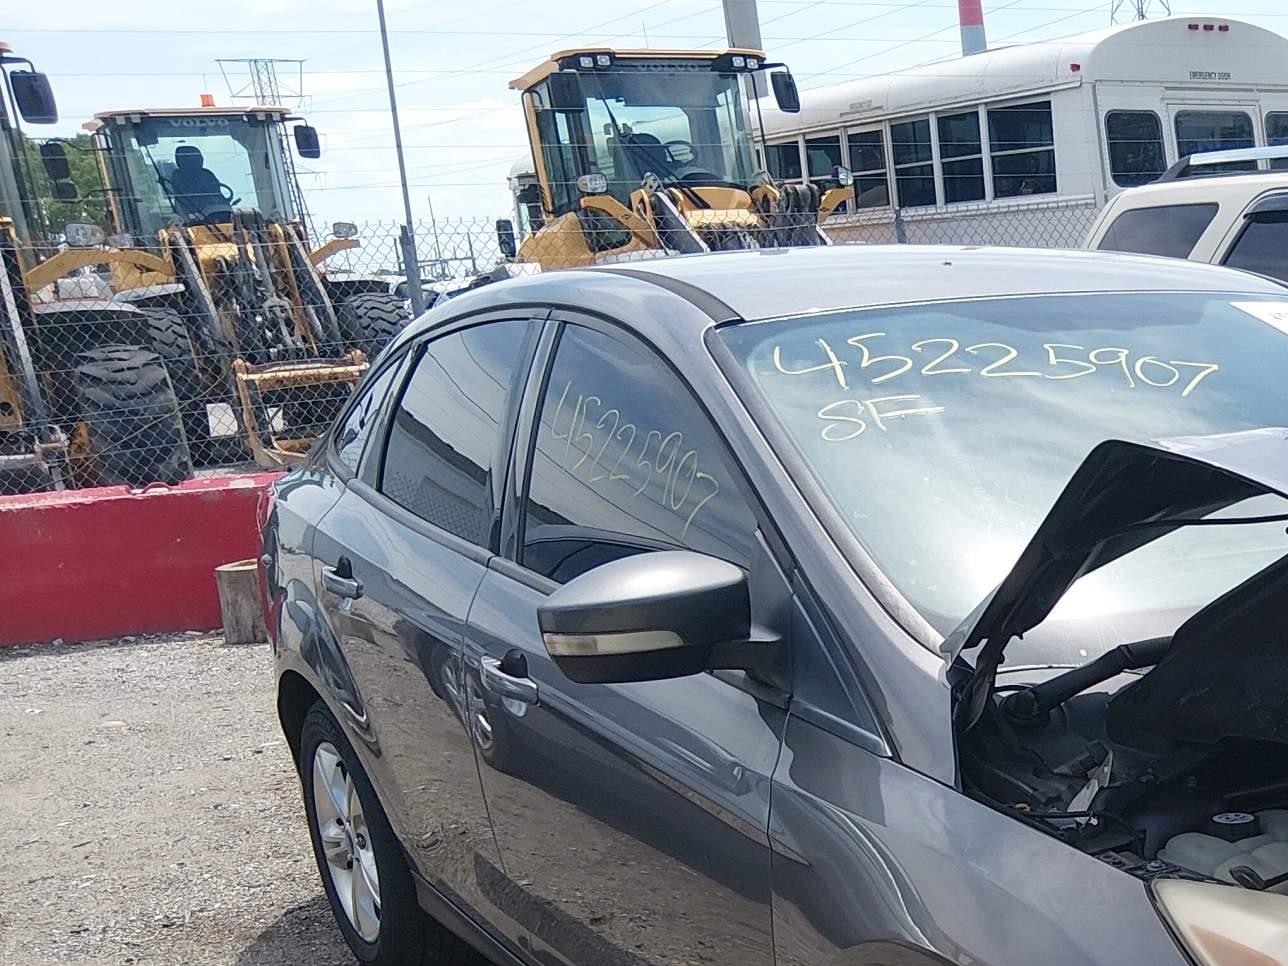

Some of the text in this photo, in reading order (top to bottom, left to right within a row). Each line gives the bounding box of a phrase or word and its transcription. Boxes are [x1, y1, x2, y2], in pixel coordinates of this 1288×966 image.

[169, 118, 230, 127] VOLVO
[774, 332, 1218, 397] 45225907
[817, 394, 945, 441] SF
[551, 379, 719, 539] 45225907
